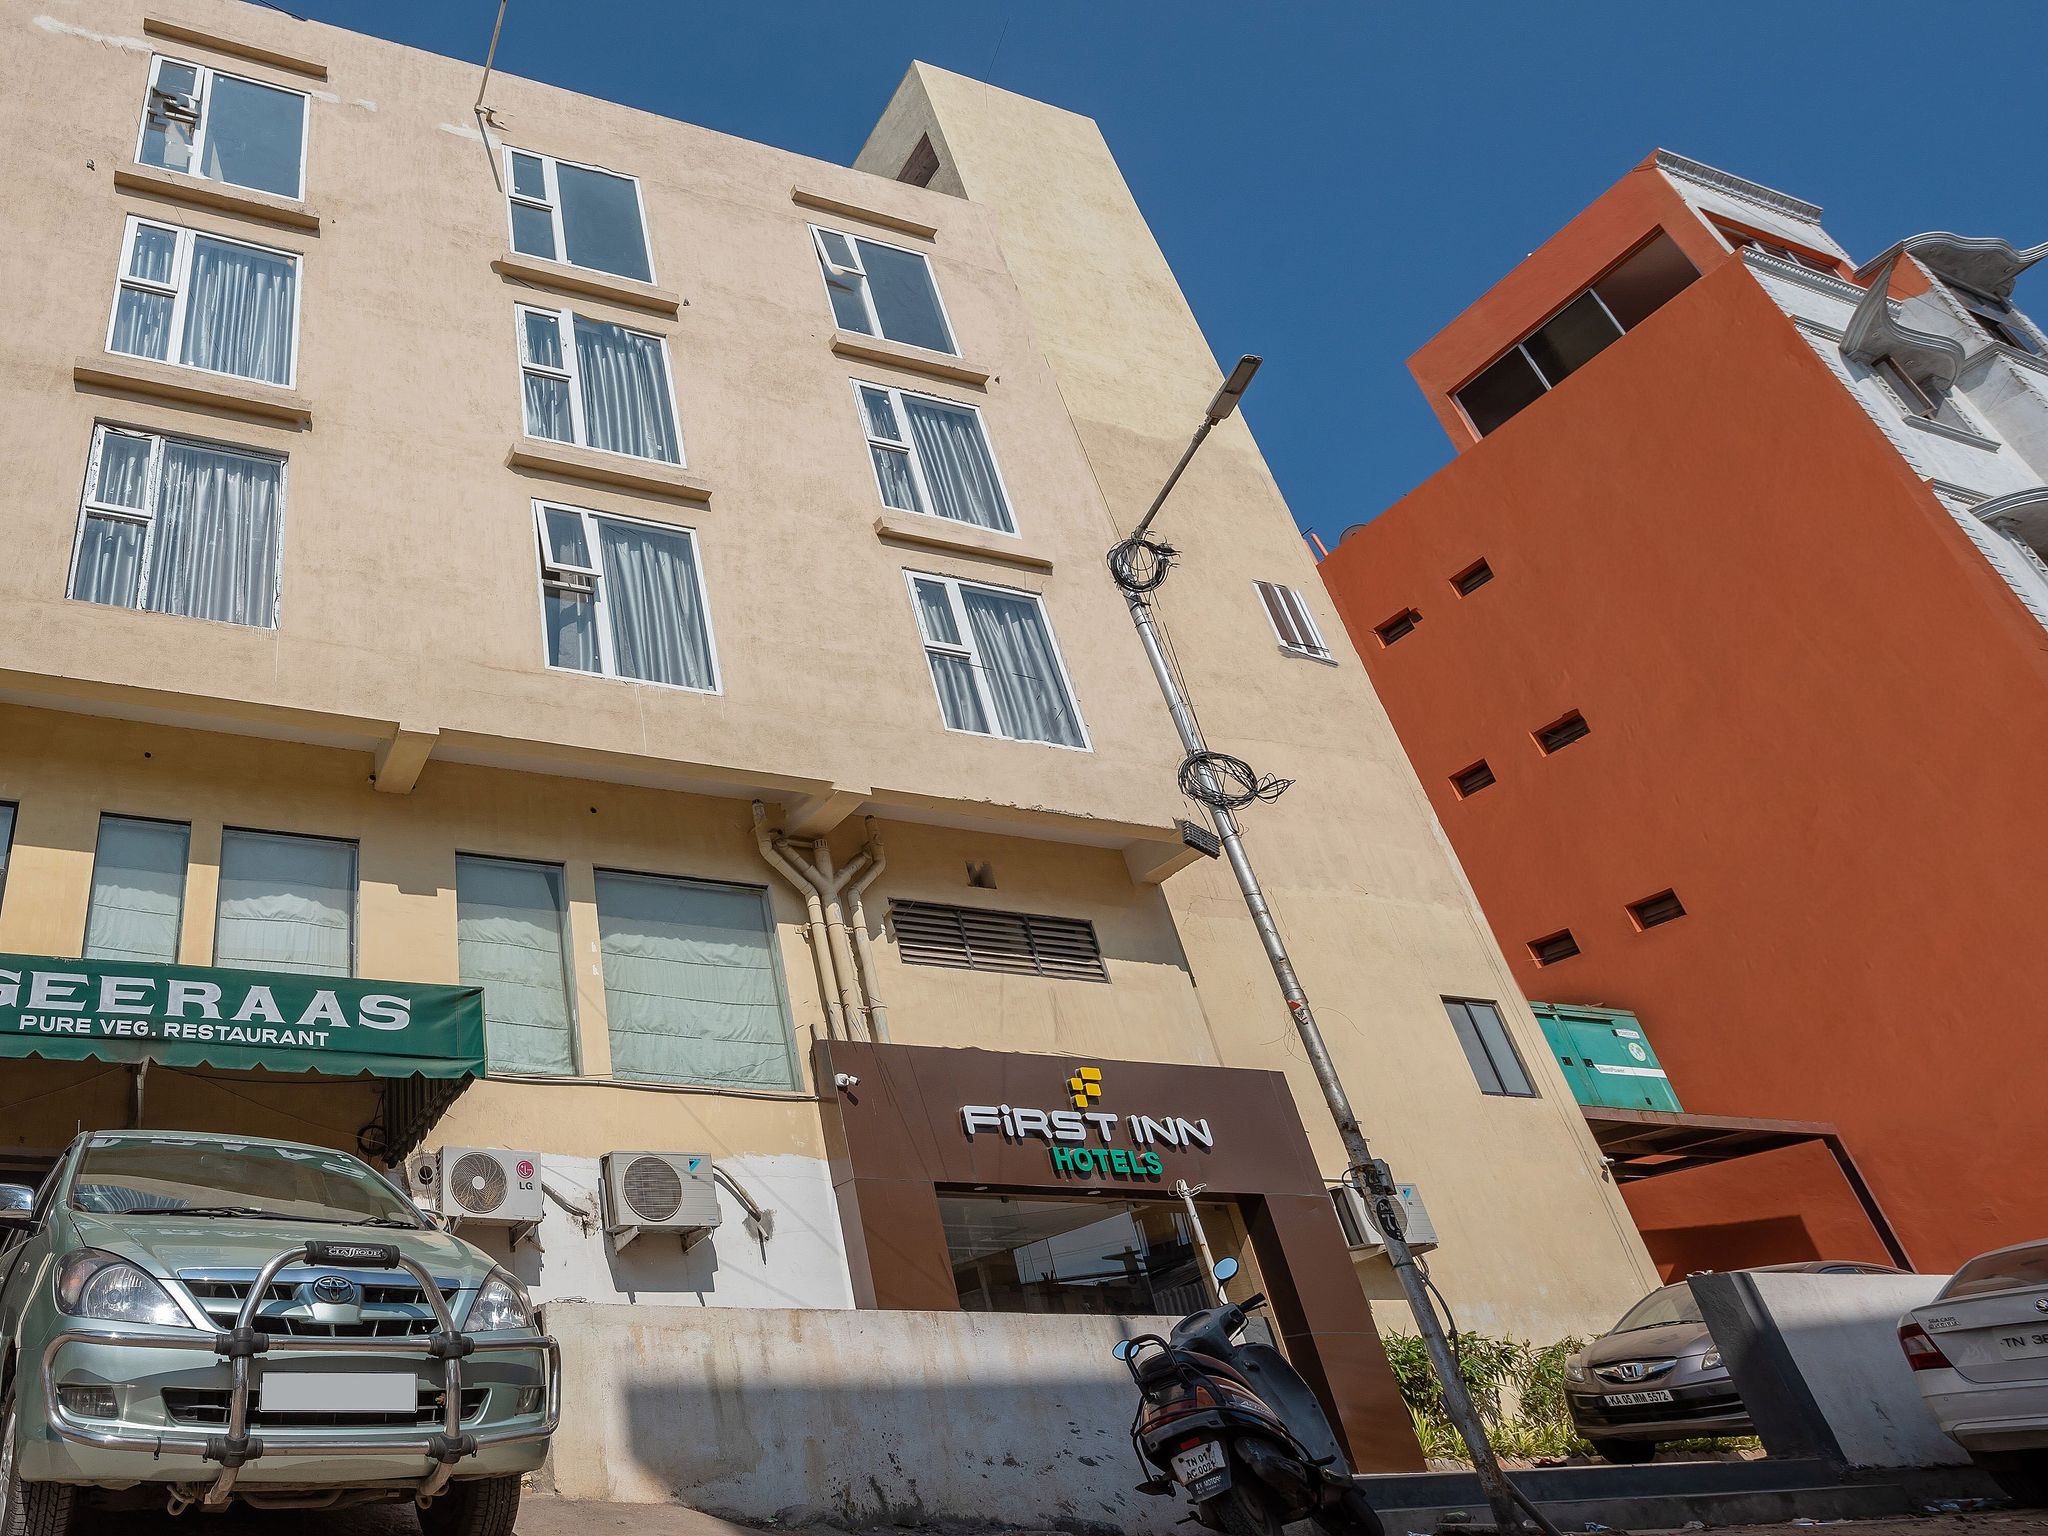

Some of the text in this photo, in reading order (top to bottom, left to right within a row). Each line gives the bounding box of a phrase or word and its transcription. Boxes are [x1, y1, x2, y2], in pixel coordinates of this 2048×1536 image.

[19, 1014, 330, 1047] PURE VEG. RESTAURANT
[1130, 1114, 1214, 1147] INN
[1052, 1146, 1165, 1176] HOTELS
[519, 1181, 533, 1191] LG
[2002, 1336, 2026, 1348] TN
[1609, 1395, 1623, 1405] KA
[1621, 1394, 1633, 1404] 05
[1647, 1391, 1669, 1402] 5572
[1186, 1457, 1198, 1468] TN
[1186, 1469, 1198, 1480] AC
